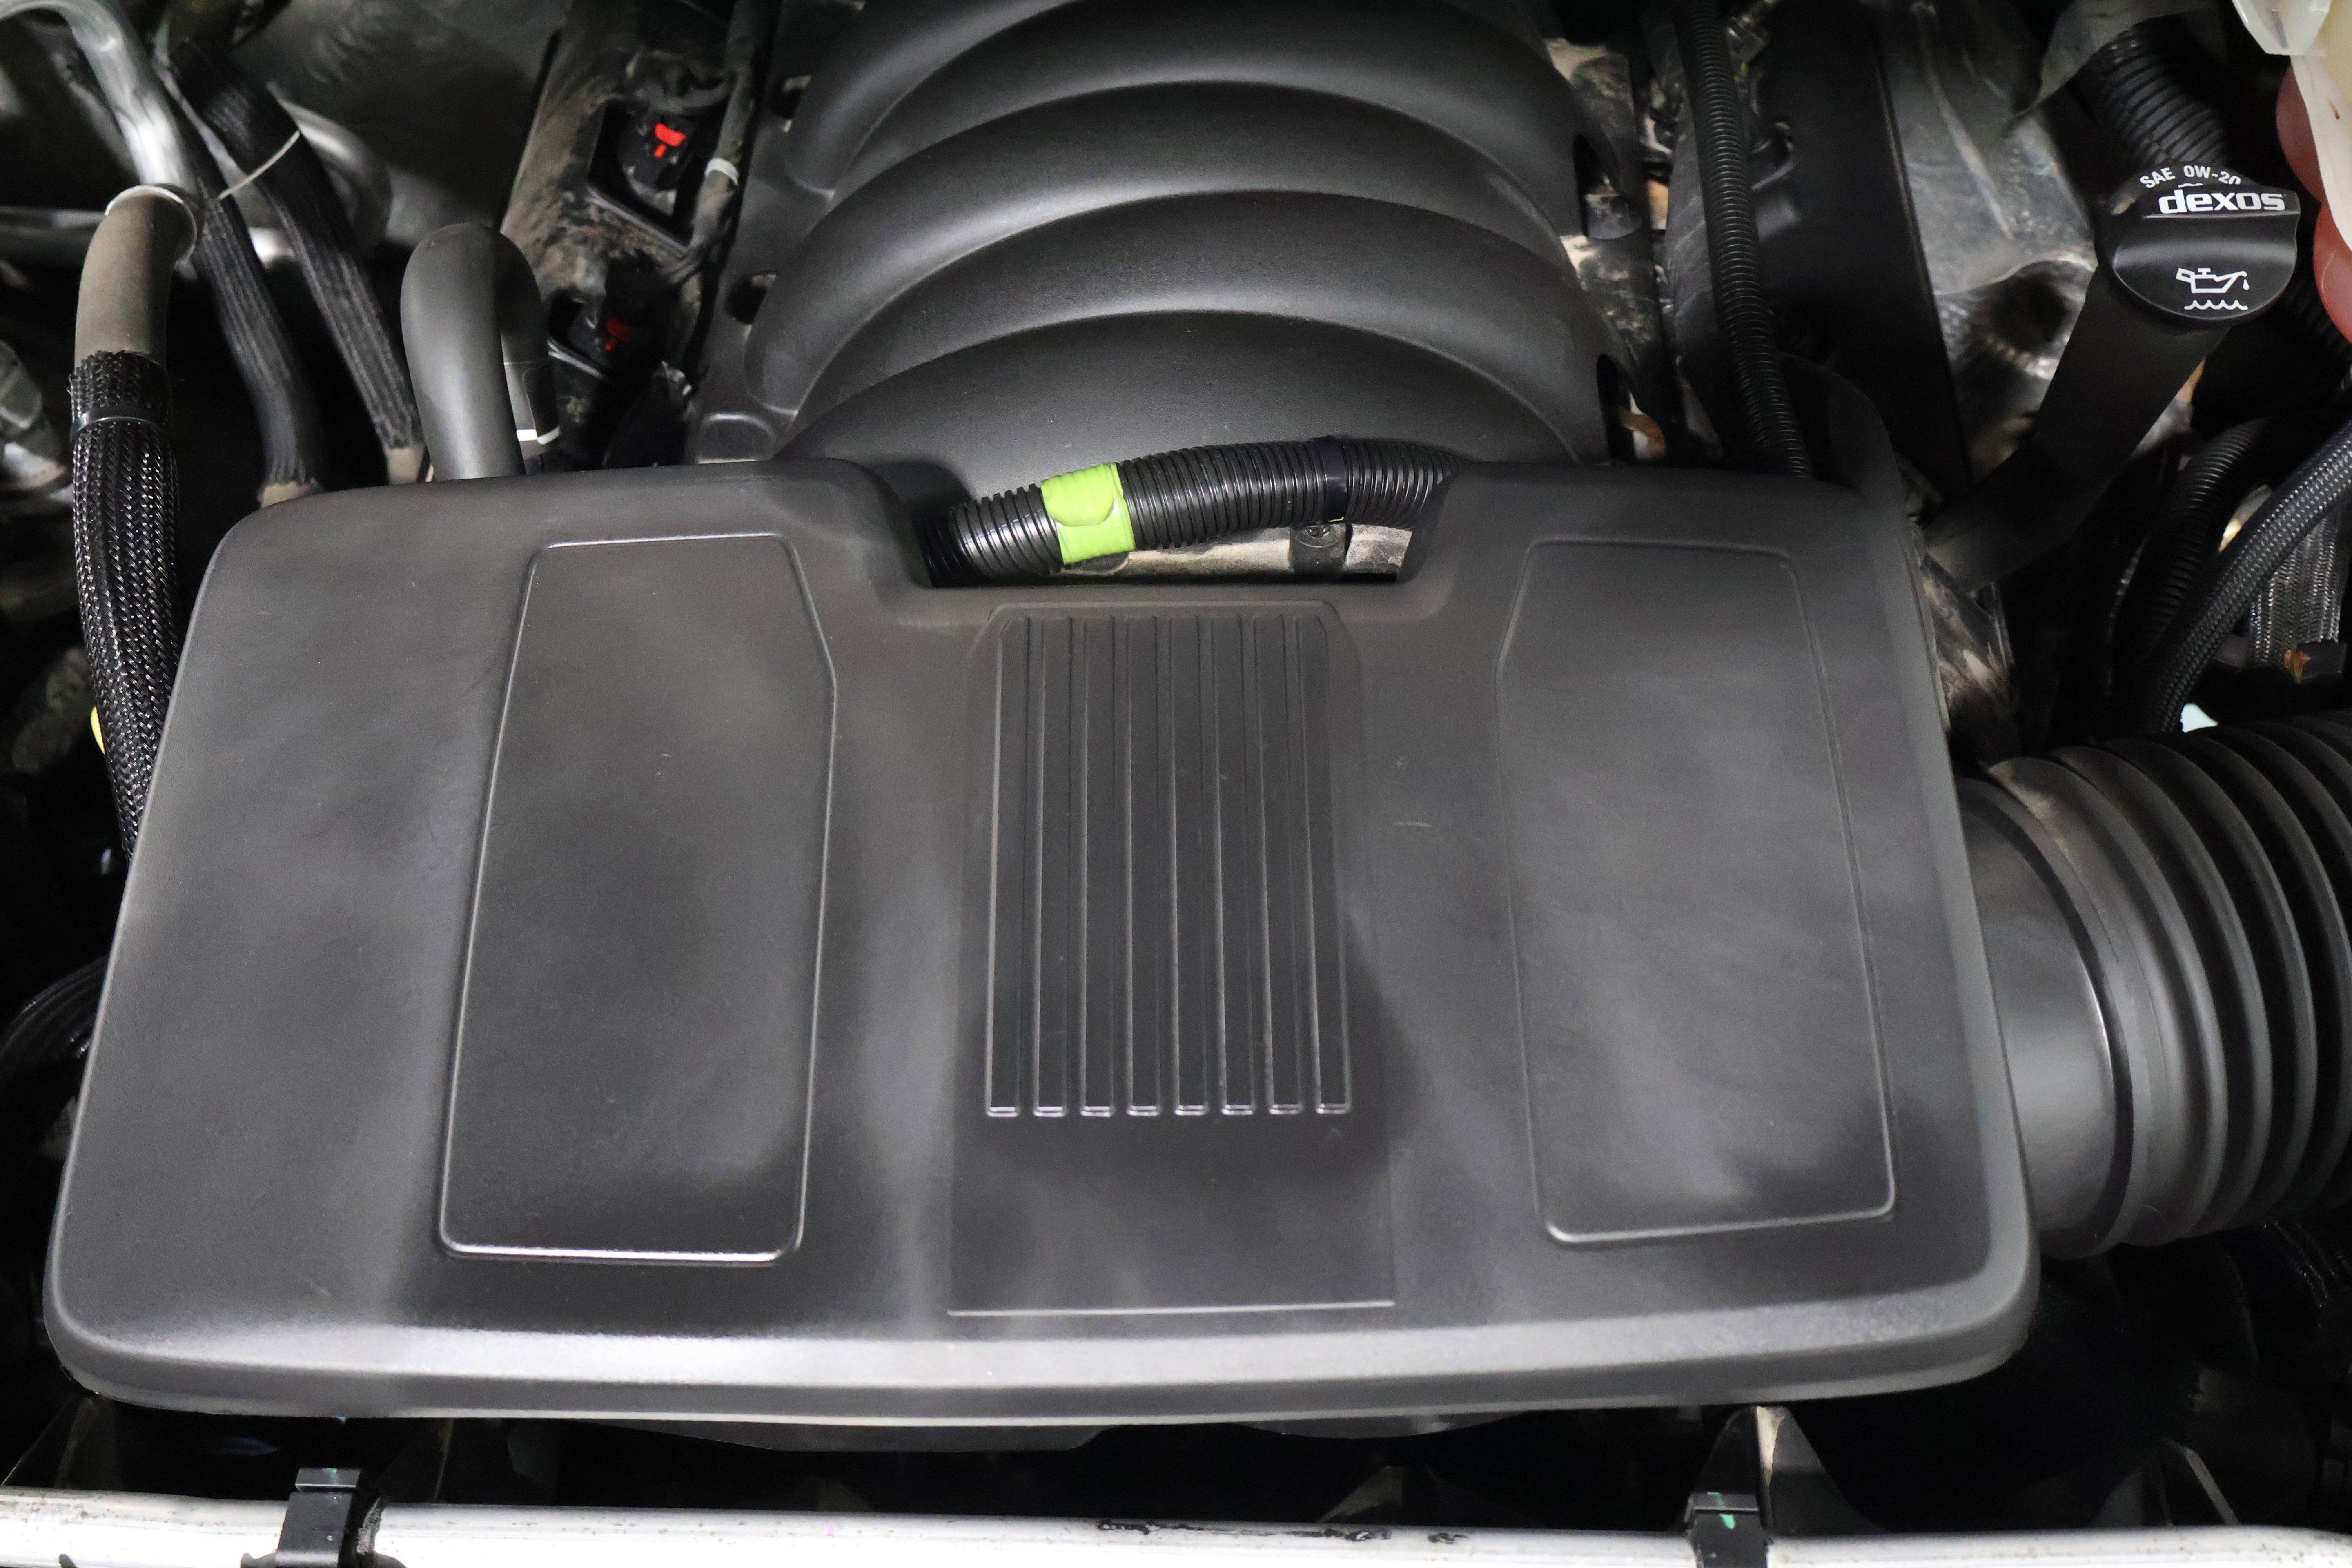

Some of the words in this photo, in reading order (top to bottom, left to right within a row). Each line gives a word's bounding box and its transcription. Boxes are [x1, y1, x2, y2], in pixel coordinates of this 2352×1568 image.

[2140, 167, 2176, 188] SAE
[2183, 165, 2241, 185] 0W-20
[2158, 189, 2285, 214] dexos
